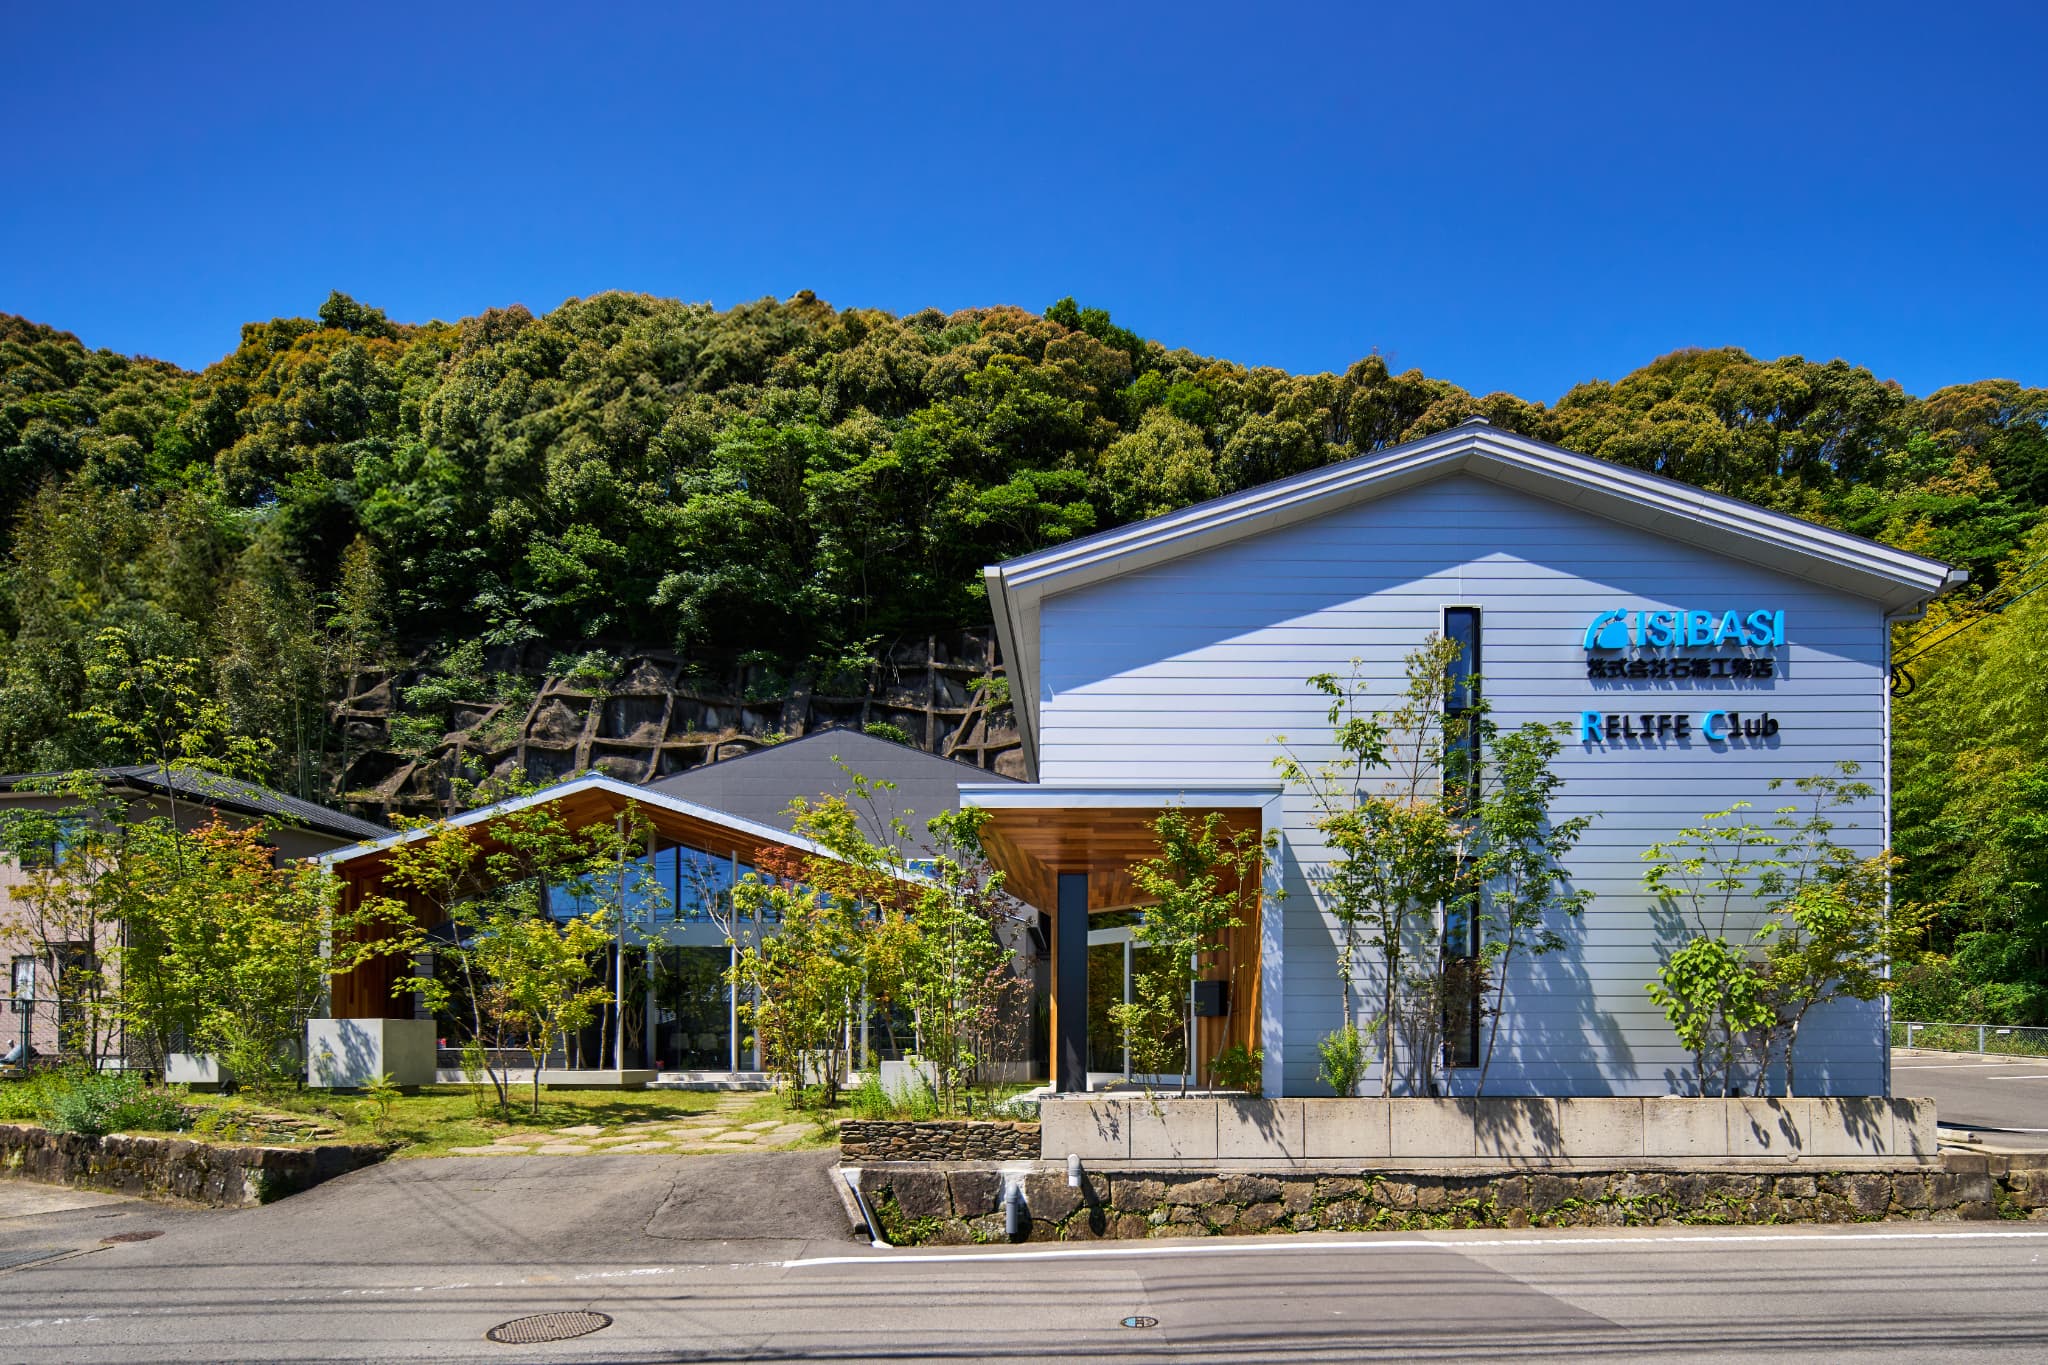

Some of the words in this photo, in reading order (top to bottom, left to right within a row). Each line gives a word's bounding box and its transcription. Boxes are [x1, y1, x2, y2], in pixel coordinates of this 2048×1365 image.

[1634, 609, 1785, 648] ISIBASI
[1581, 710, 1690, 743] RELIFE
[1702, 709, 1780, 741] Club
